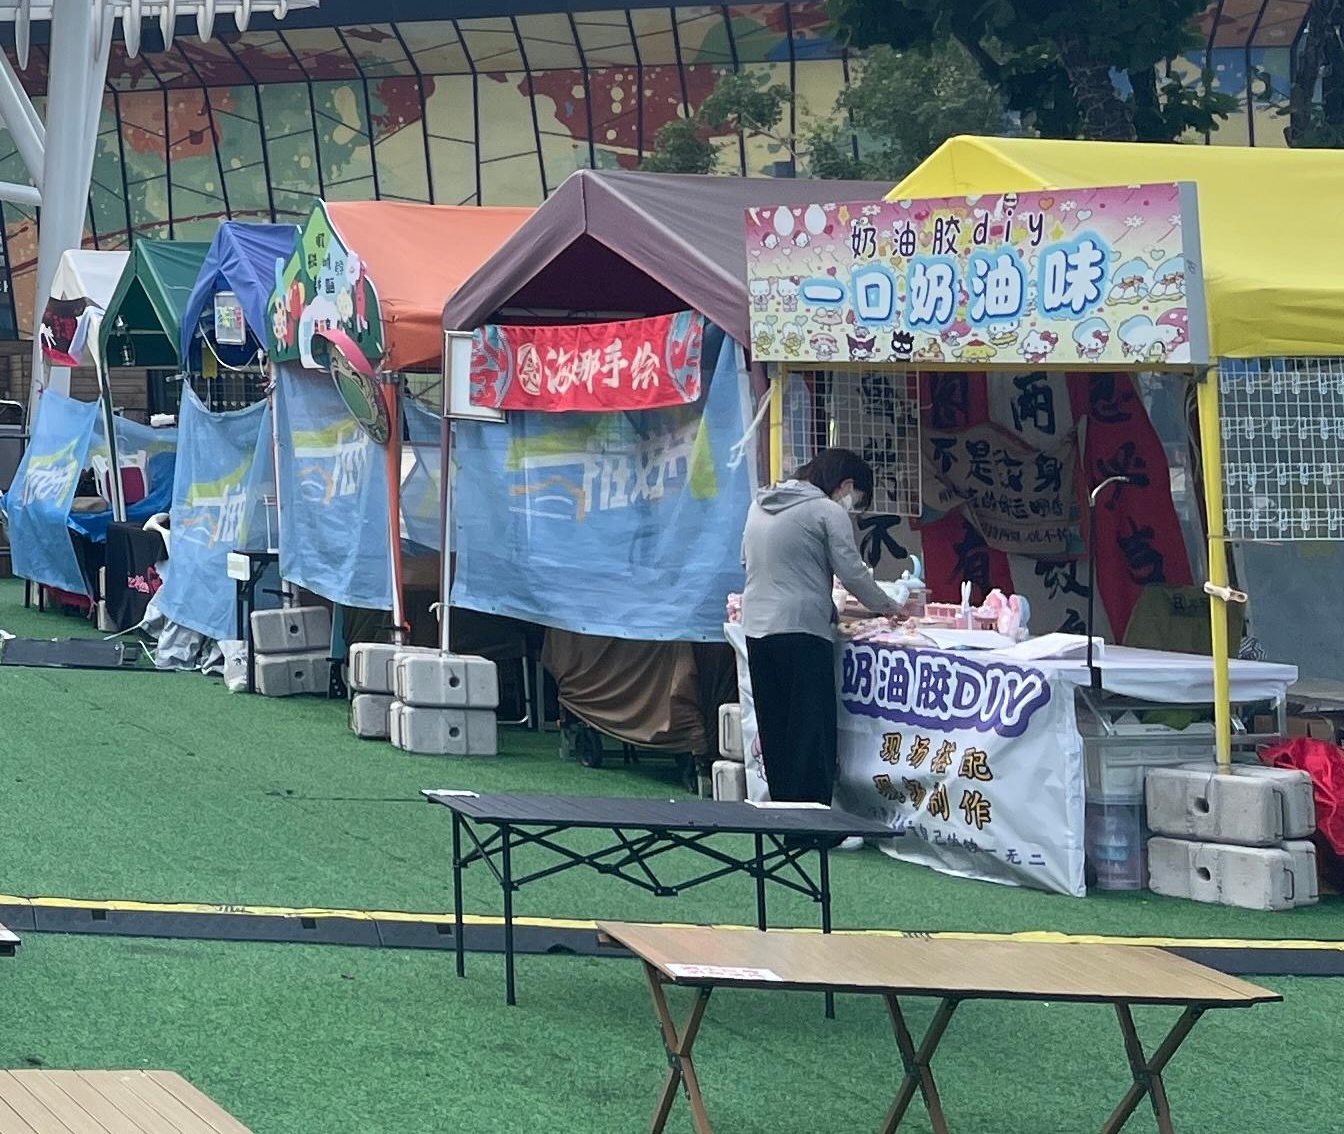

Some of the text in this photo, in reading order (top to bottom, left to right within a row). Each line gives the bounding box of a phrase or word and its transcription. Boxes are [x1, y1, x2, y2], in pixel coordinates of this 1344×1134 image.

[802, 240, 1106, 324] 一口奶油味
[544, 338, 660, 394] 海娜手绘
[879, 732, 993, 781] 现场搭配
